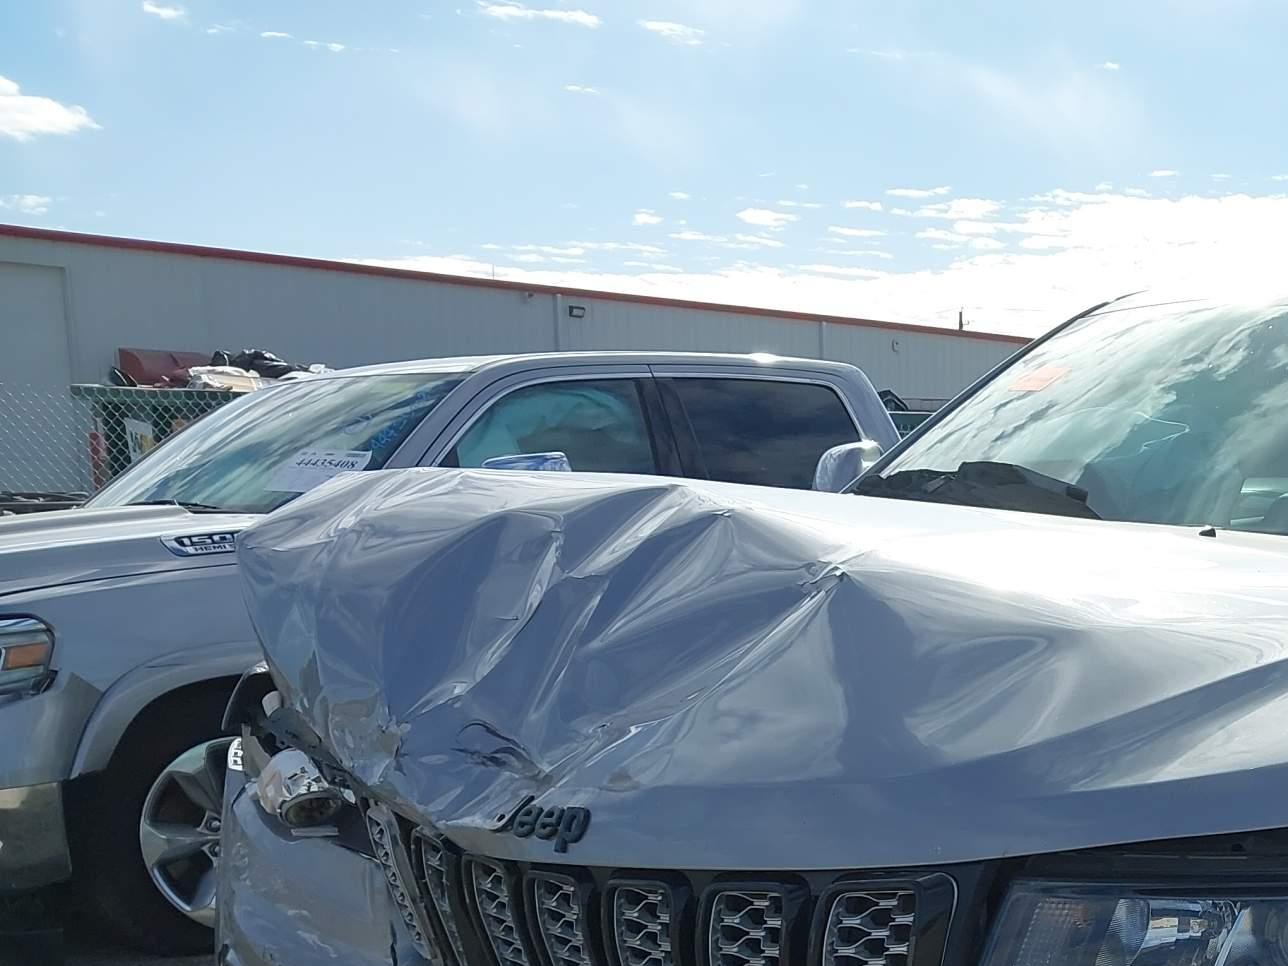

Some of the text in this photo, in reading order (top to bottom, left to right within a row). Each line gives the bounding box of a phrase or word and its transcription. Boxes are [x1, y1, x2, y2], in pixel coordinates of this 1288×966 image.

[180, 533, 235, 547] 150
[194, 543, 228, 552] HEMI
[489, 795, 592, 853] Jeep
